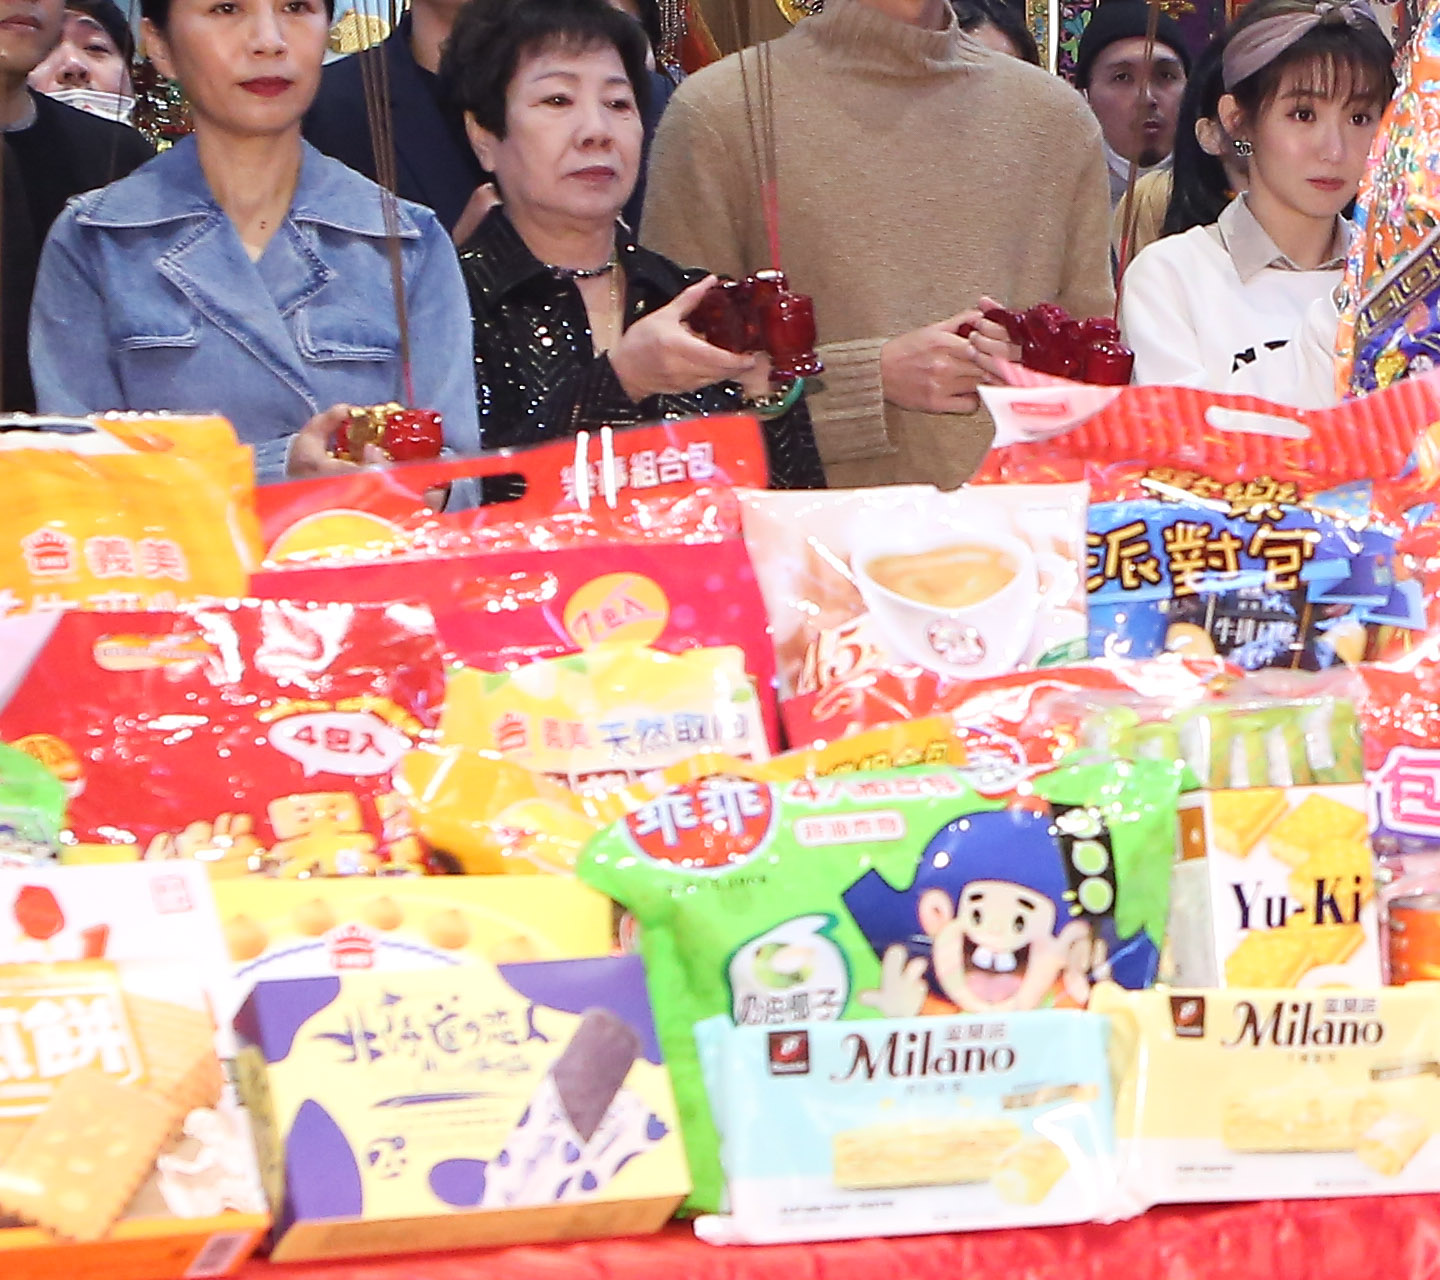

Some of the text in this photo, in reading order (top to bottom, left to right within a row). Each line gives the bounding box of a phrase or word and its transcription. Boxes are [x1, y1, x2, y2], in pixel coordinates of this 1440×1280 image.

[1085, 519, 1318, 599] 派對包
[633, 779, 763, 847] 乖乖
[1231, 875, 1363, 930] Yu-Ki
[1220, 1000, 1385, 1048] Milano
[828, 1028, 1017, 1082] Milano
